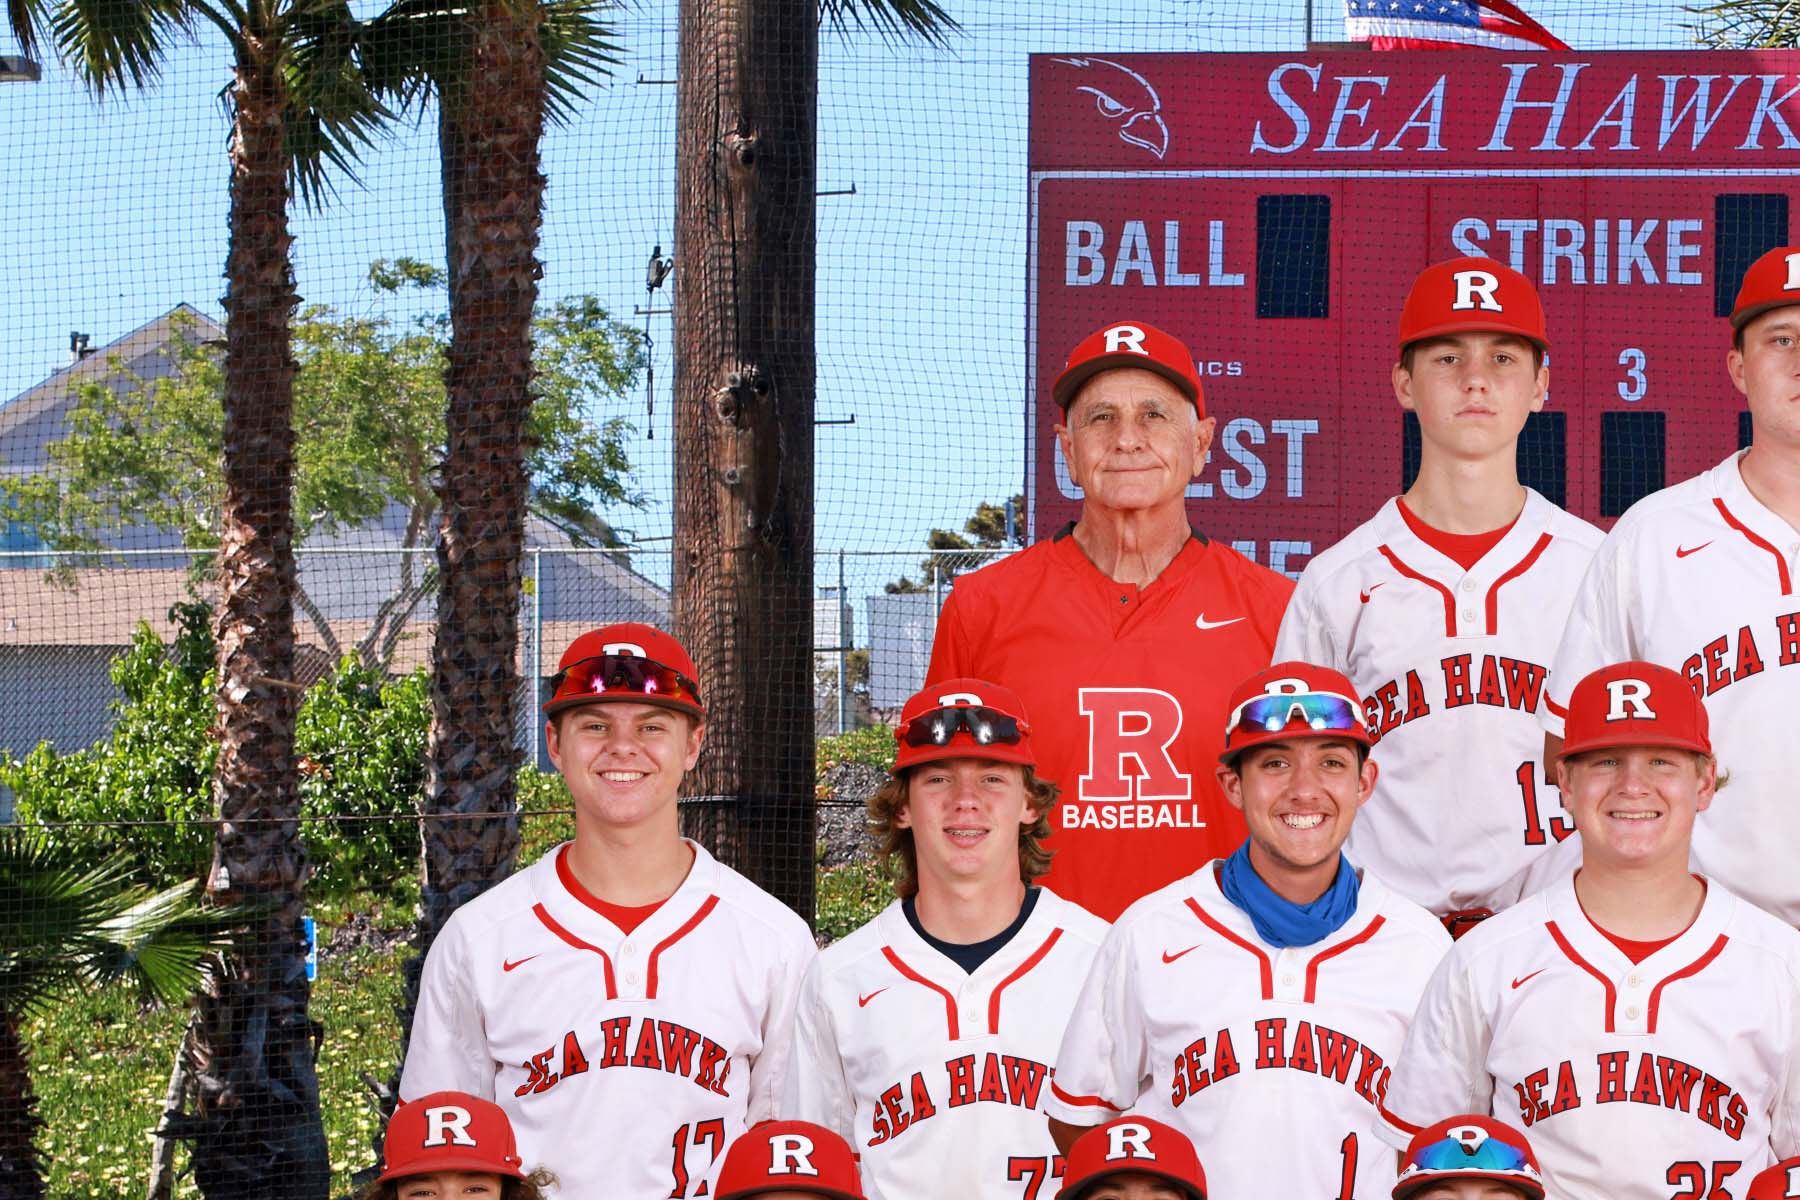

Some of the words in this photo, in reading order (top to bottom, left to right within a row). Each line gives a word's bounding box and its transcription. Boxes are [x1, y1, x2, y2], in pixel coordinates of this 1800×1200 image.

[1251, 62, 1448, 153] SEA
[1064, 219, 1245, 287] BALL
[1450, 217, 1704, 285] STRIKE
[1452, 270, 1503, 312] R
[1104, 326, 1148, 355] R
[1617, 347, 1648, 402] 3
[1681, 625, 1764, 697] SEA
[1364, 670, 1430, 744] SEA
[1441, 655, 1551, 713] HAW
[1605, 678, 1656, 721] R
[1078, 687, 1191, 801] R
[1062, 804, 1206, 829] BASEBALL
[1171, 1028, 1240, 1109] SEA
[1255, 1017, 1392, 1110] HAWKS
[1596, 1052, 1748, 1141] HAWKS
[423, 1106, 477, 1148] R
[867, 1071, 936, 1147] SEA
[948, 1052, 1055, 1110] HAW
[667, 1117, 726, 1200] 17
[767, 1134, 818, 1177] R
[1105, 1123, 1156, 1161] R
